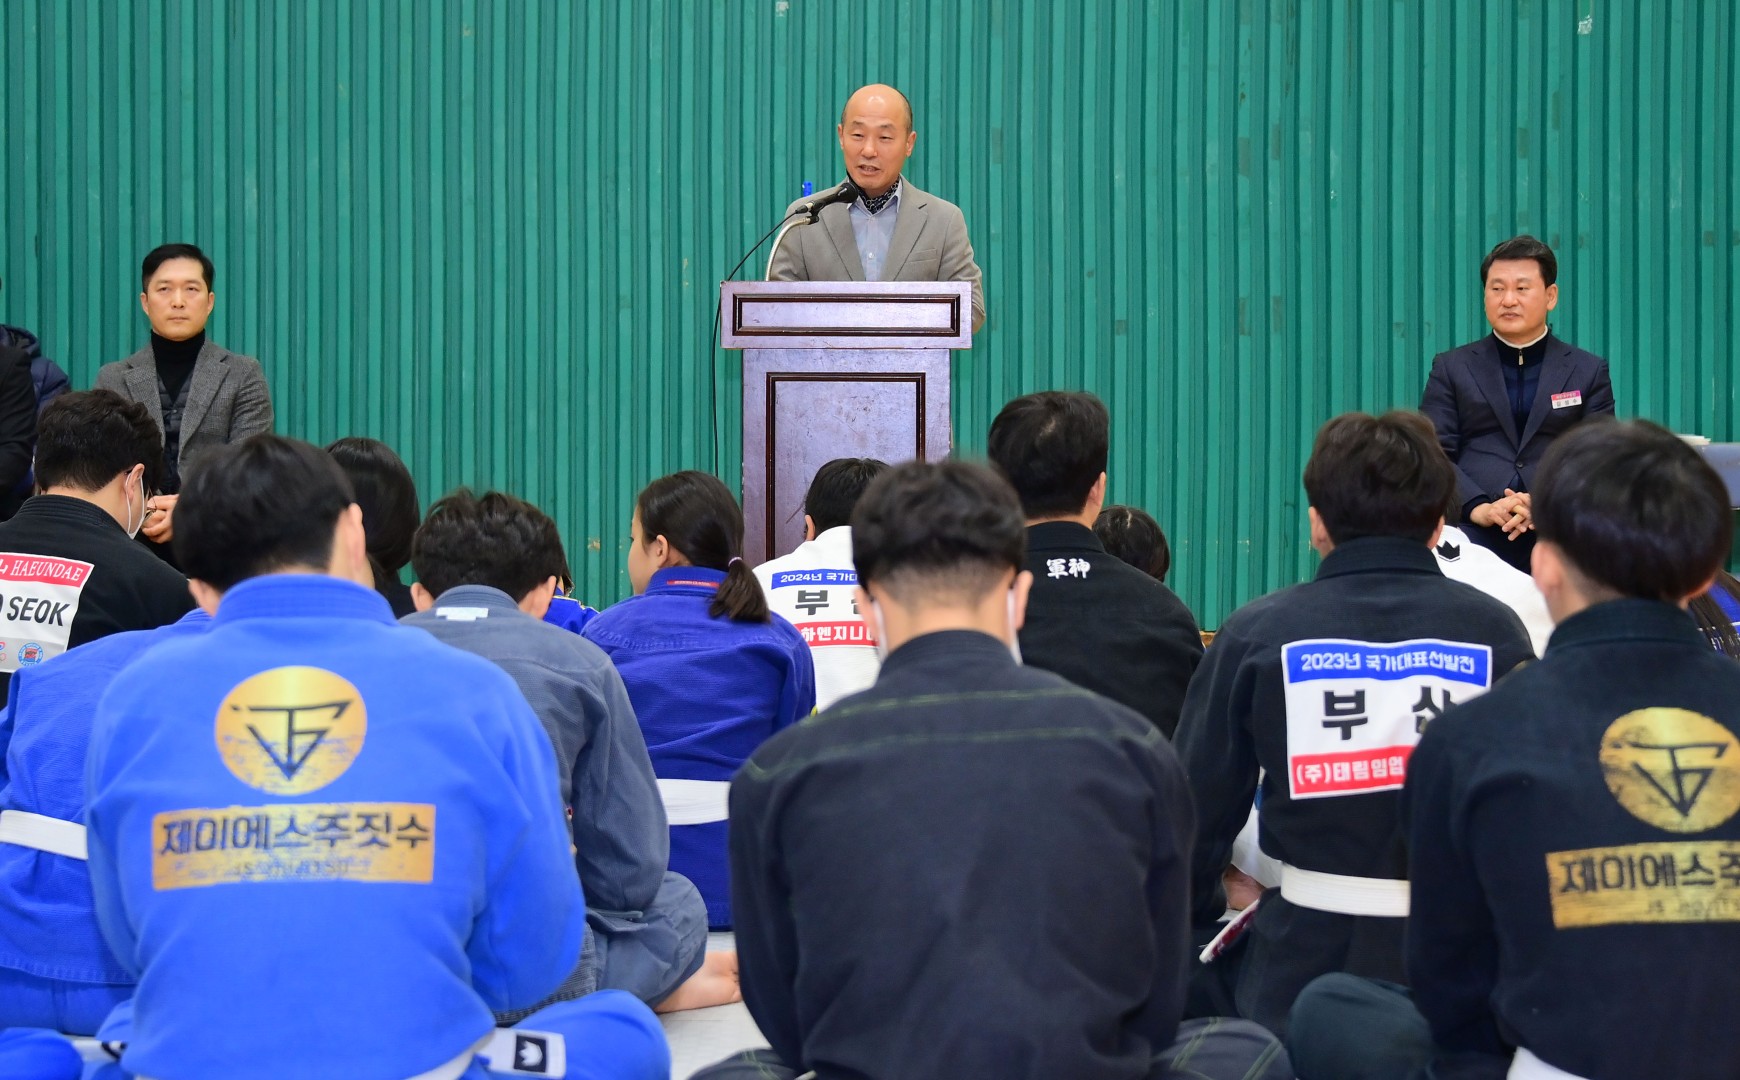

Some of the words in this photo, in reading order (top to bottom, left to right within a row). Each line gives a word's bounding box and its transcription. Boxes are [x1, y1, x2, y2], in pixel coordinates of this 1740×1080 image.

[10, 560, 84, 582] HAEUNDAE
[780, 573, 822, 583] 2024년
[1046, 558, 1091, 579] 軍神
[6, 596, 71, 627] SEOK
[795, 590, 829, 616] 부
[800, 625, 874, 642] 하엔지니
[1300, 652, 1361, 672] 2023년
[1366, 650, 1475, 675] 국가대표선발전
[1322, 689, 1368, 741] 부
[161, 812, 430, 855] 제이에스주짓수
